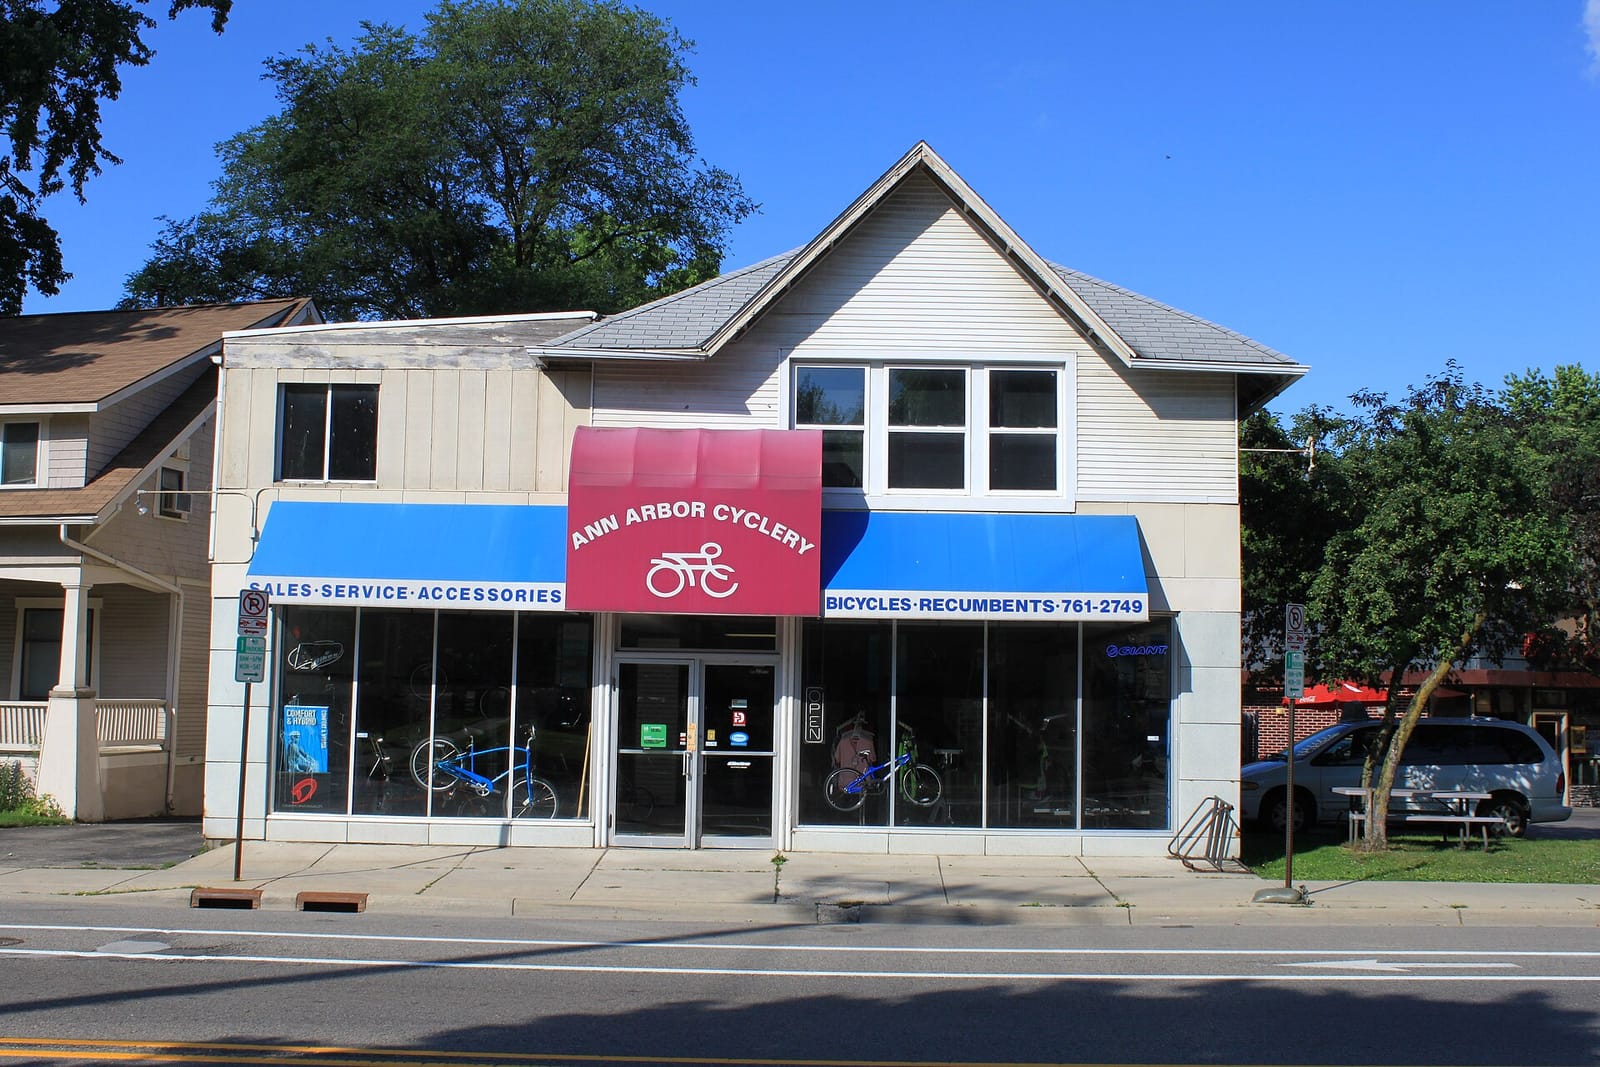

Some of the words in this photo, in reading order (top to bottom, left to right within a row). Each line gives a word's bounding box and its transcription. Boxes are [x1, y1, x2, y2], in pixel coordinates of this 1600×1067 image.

[571, 514, 620, 550] ANN
[625, 501, 706, 526] ARBOR
[713, 504, 815, 556] CYCLERY
[321, 584, 408, 599] SERVICE
[418, 586, 562, 603] ACCESSORIES
[826, 596, 911, 611] BICYCLES
[919, 598, 1055, 612] RECUMBENTS
[1061, 599, 1143, 613] 761-2749
[1119, 645, 1168, 656] GIANT
[286, 709, 316, 718] COMFORT
[286, 717, 292, 725] &
[293, 717, 317, 726] HYBRID
[809, 690, 820, 740] OPEN
